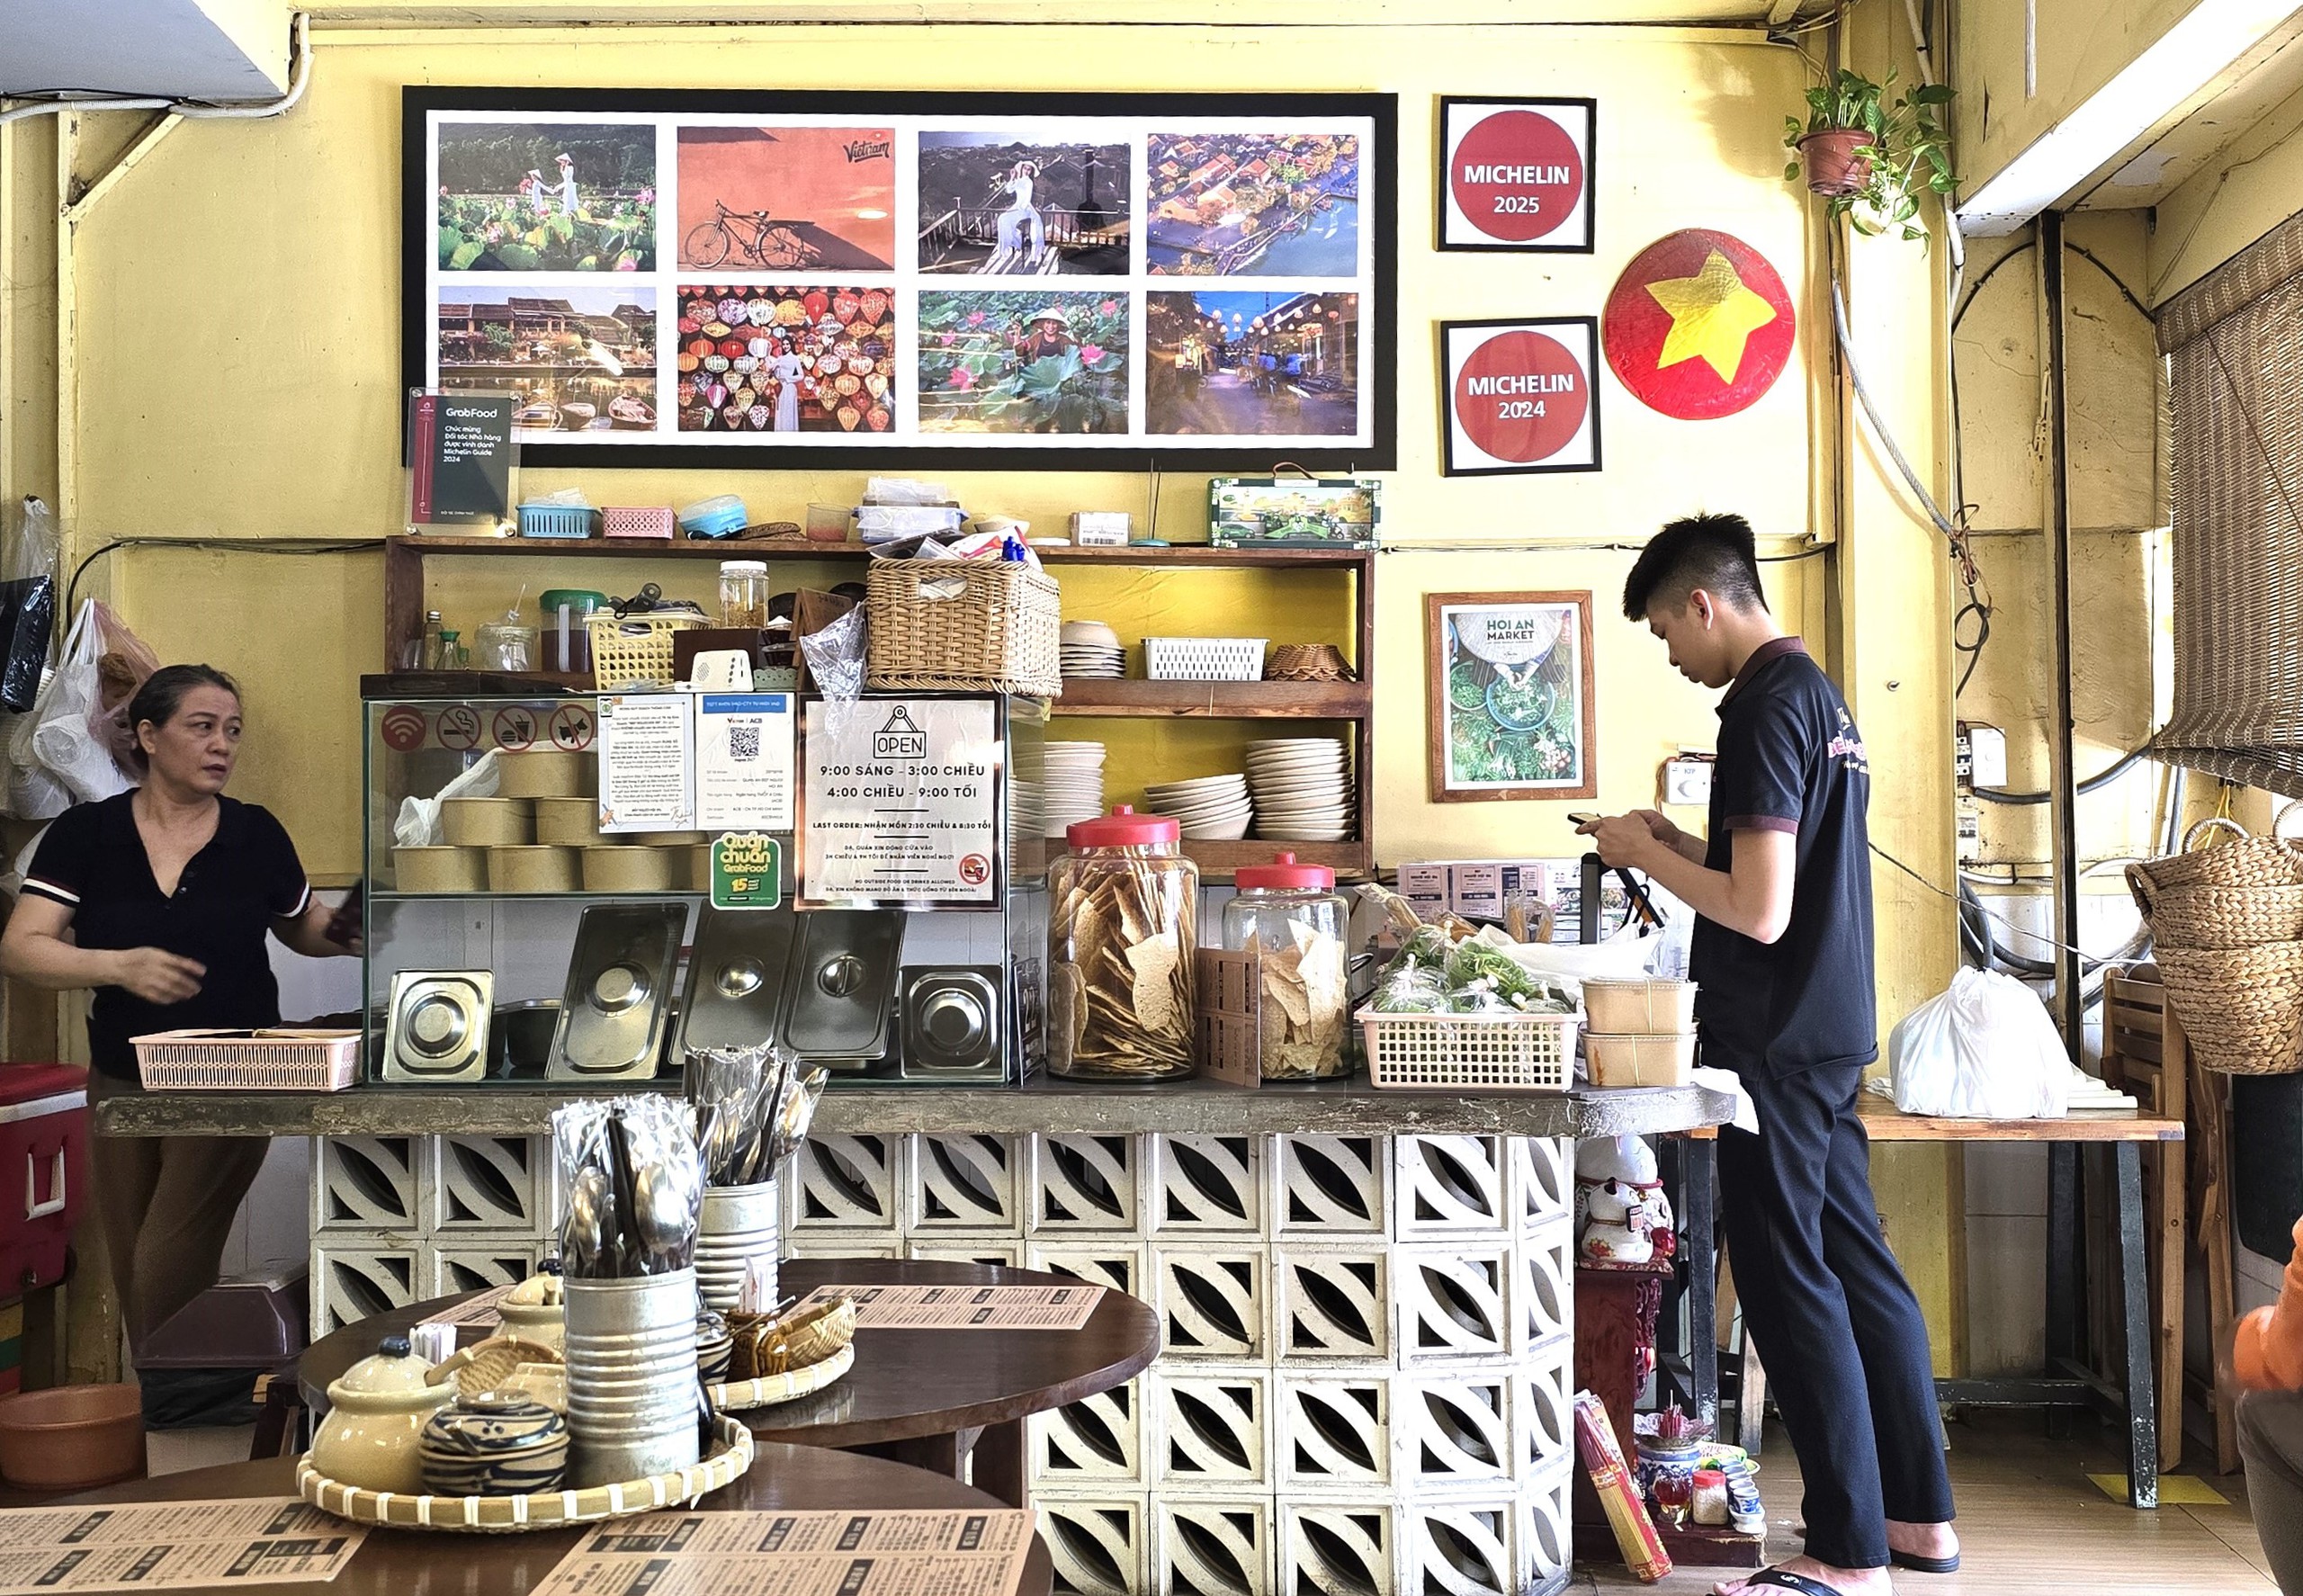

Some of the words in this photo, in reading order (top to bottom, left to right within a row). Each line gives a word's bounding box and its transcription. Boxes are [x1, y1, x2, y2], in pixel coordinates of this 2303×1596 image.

[843, 140, 890, 163] Vietnam
[1464, 165, 1570, 184] MICHELIN
[1493, 196, 1540, 213] 2025
[1467, 373, 1574, 396] MICHELIN
[445, 408, 498, 418] GrabFood
[1499, 400, 1546, 418] 2024
[1487, 620, 1511, 631] HOI
[1515, 619, 1535, 630] AN
[1487, 631, 1535, 640] MARKET
[877, 737, 923, 753] OPEN
[820, 766, 850, 776] 9:00
[855, 763, 894, 776] SÁNG
[908, 766, 938, 776] 3:00
[943, 762, 985, 776] CHIỀU
[827, 787, 858, 798] 4:00
[863, 784, 904, 798] CHIỀU
[919, 787, 949, 797] 9:00
[954, 784, 977, 797] TỐI
[865, 820, 887, 830] NHẬN
[889, 820, 907, 829] MÓN
[978, 820, 991, 829] TỐI
[722, 832, 769, 849] Quán
[723, 864, 768, 874] GrabFood
[731, 878, 748, 892] 15
